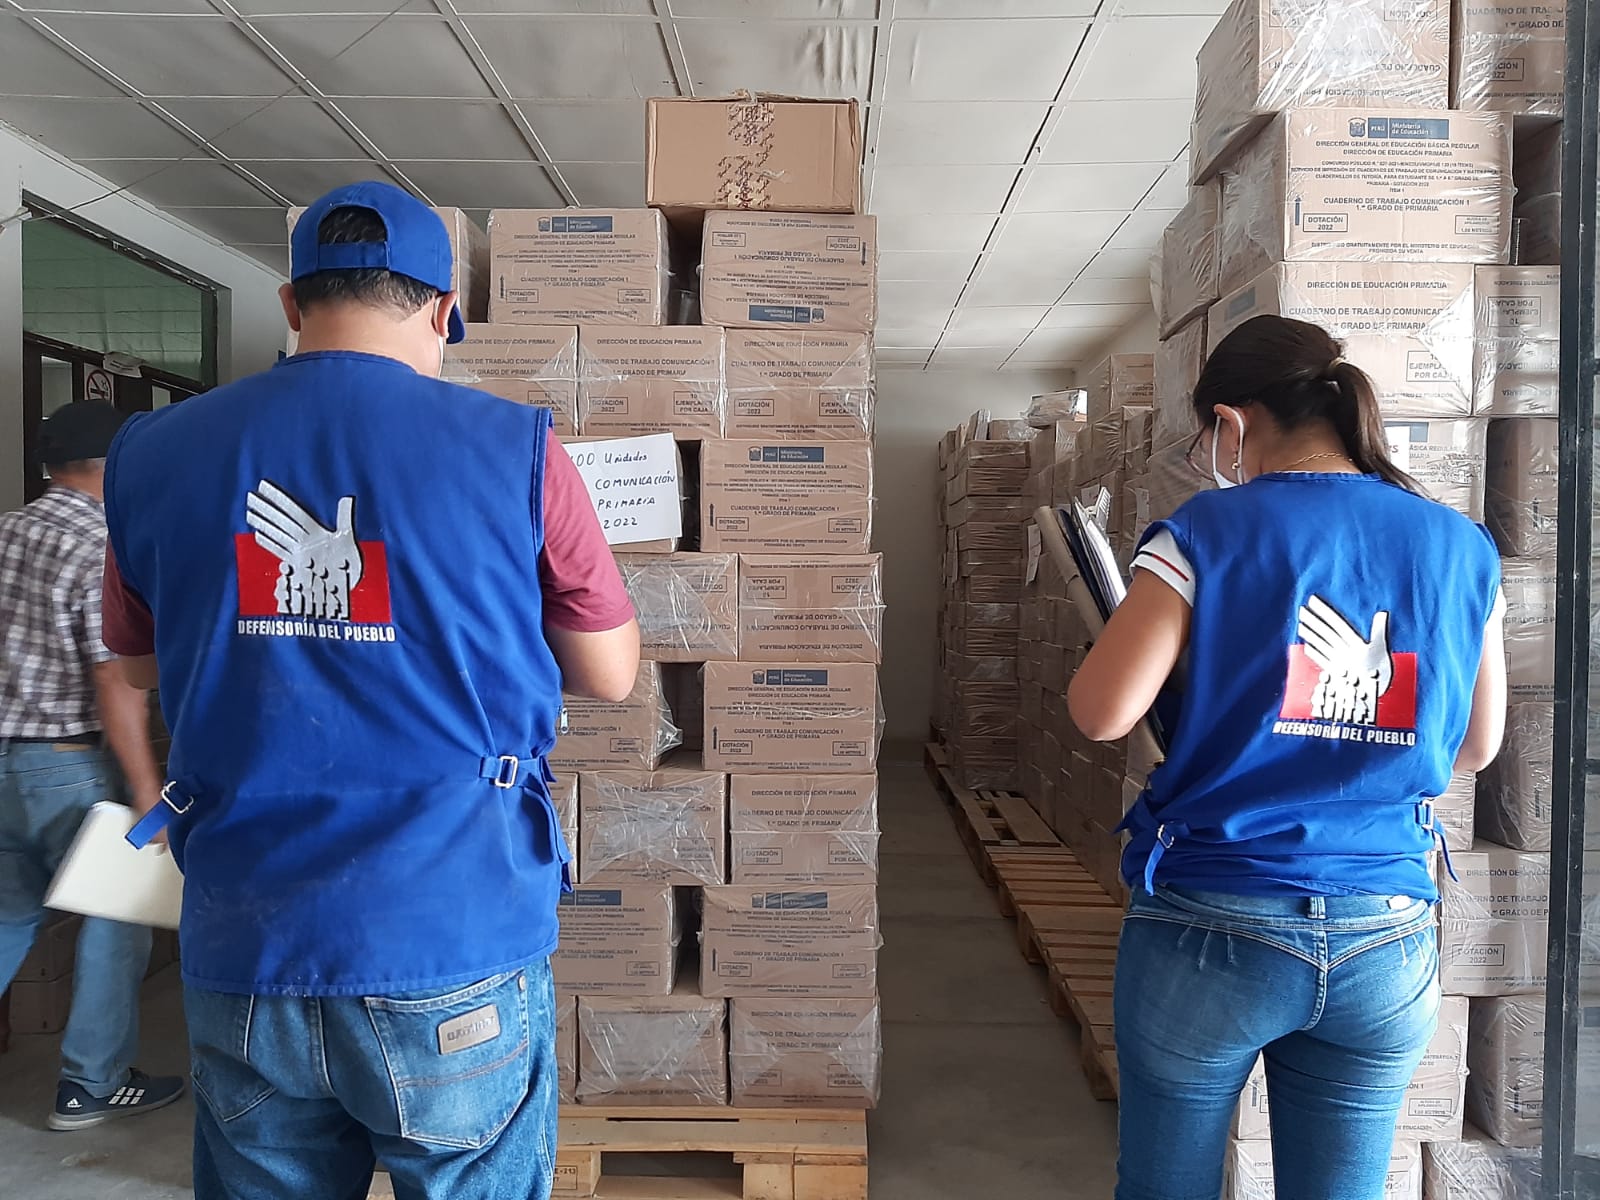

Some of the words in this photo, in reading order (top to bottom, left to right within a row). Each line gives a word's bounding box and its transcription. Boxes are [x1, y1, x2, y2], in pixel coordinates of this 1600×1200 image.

[1516, 7, 1529, 15] DE
[1518, 20, 1550, 29] GRADO
[1307, 280, 1350, 289] DIRECCIÓN
[1363, 280, 1410, 289] EDUCACIÓN
[1340, 322, 1371, 330] GRADO
[1387, 322, 1426, 330] PRIMARIA
[595, 470, 676, 490] COMUNICACIÓN
[597, 497, 655, 511] PRIMARIA
[603, 517, 638, 529] 2022
[238, 618, 316, 638] DEFENSORÍA
[318, 623, 341, 639] DEL
[344, 626, 395, 642] PUEBLO
[1272, 721, 1341, 739] DEFENSORÍA
[1341, 726, 1363, 742] DEL
[1366, 729, 1416, 746] PUEBLO
[1466, 869, 1508, 877] DIRECCIÓN
[1497, 895, 1509, 903] DE
